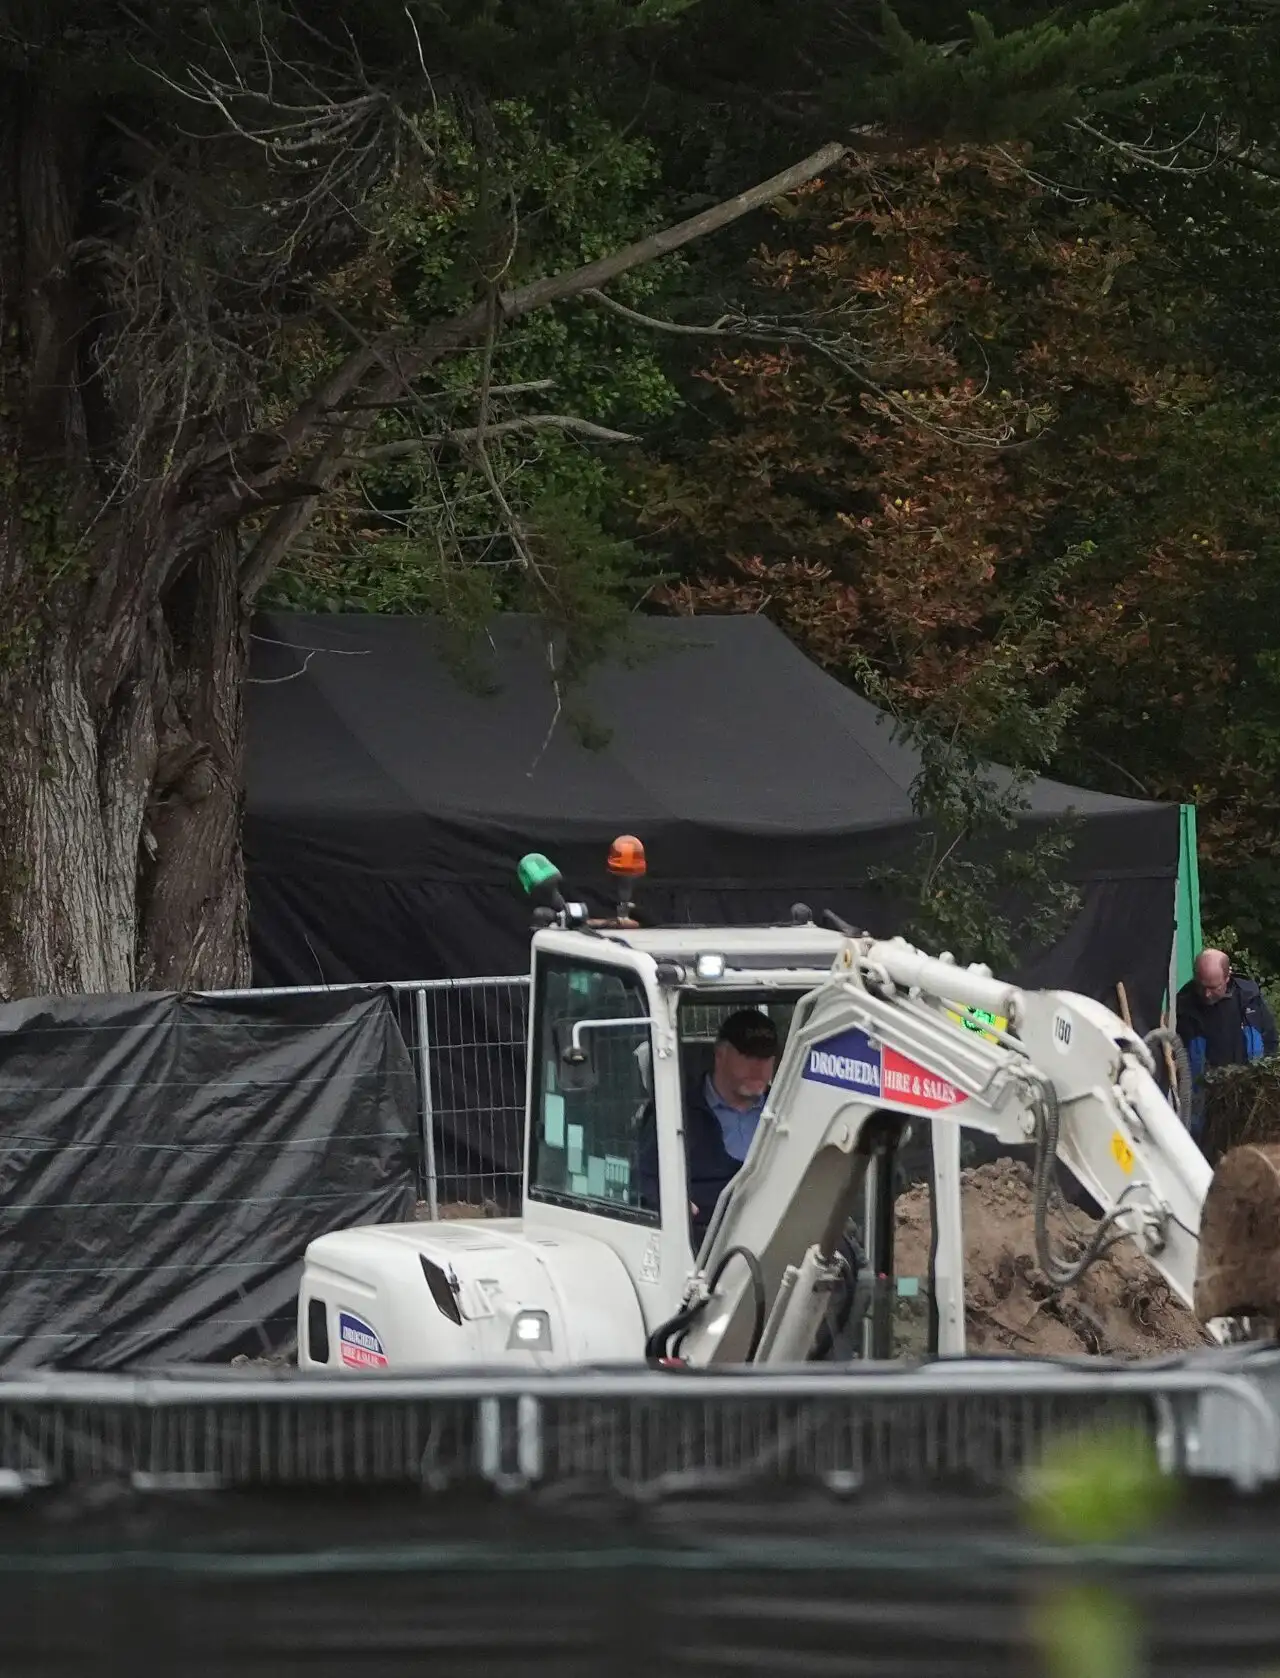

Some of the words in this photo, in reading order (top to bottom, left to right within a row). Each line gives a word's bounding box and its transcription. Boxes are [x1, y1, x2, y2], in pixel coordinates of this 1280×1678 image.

[810, 1050, 880, 1088] DROGHEDA
[884, 1069, 910, 1094] HIRE
[911, 1076, 921, 1096] &
[922, 1078, 957, 1103] SALES
